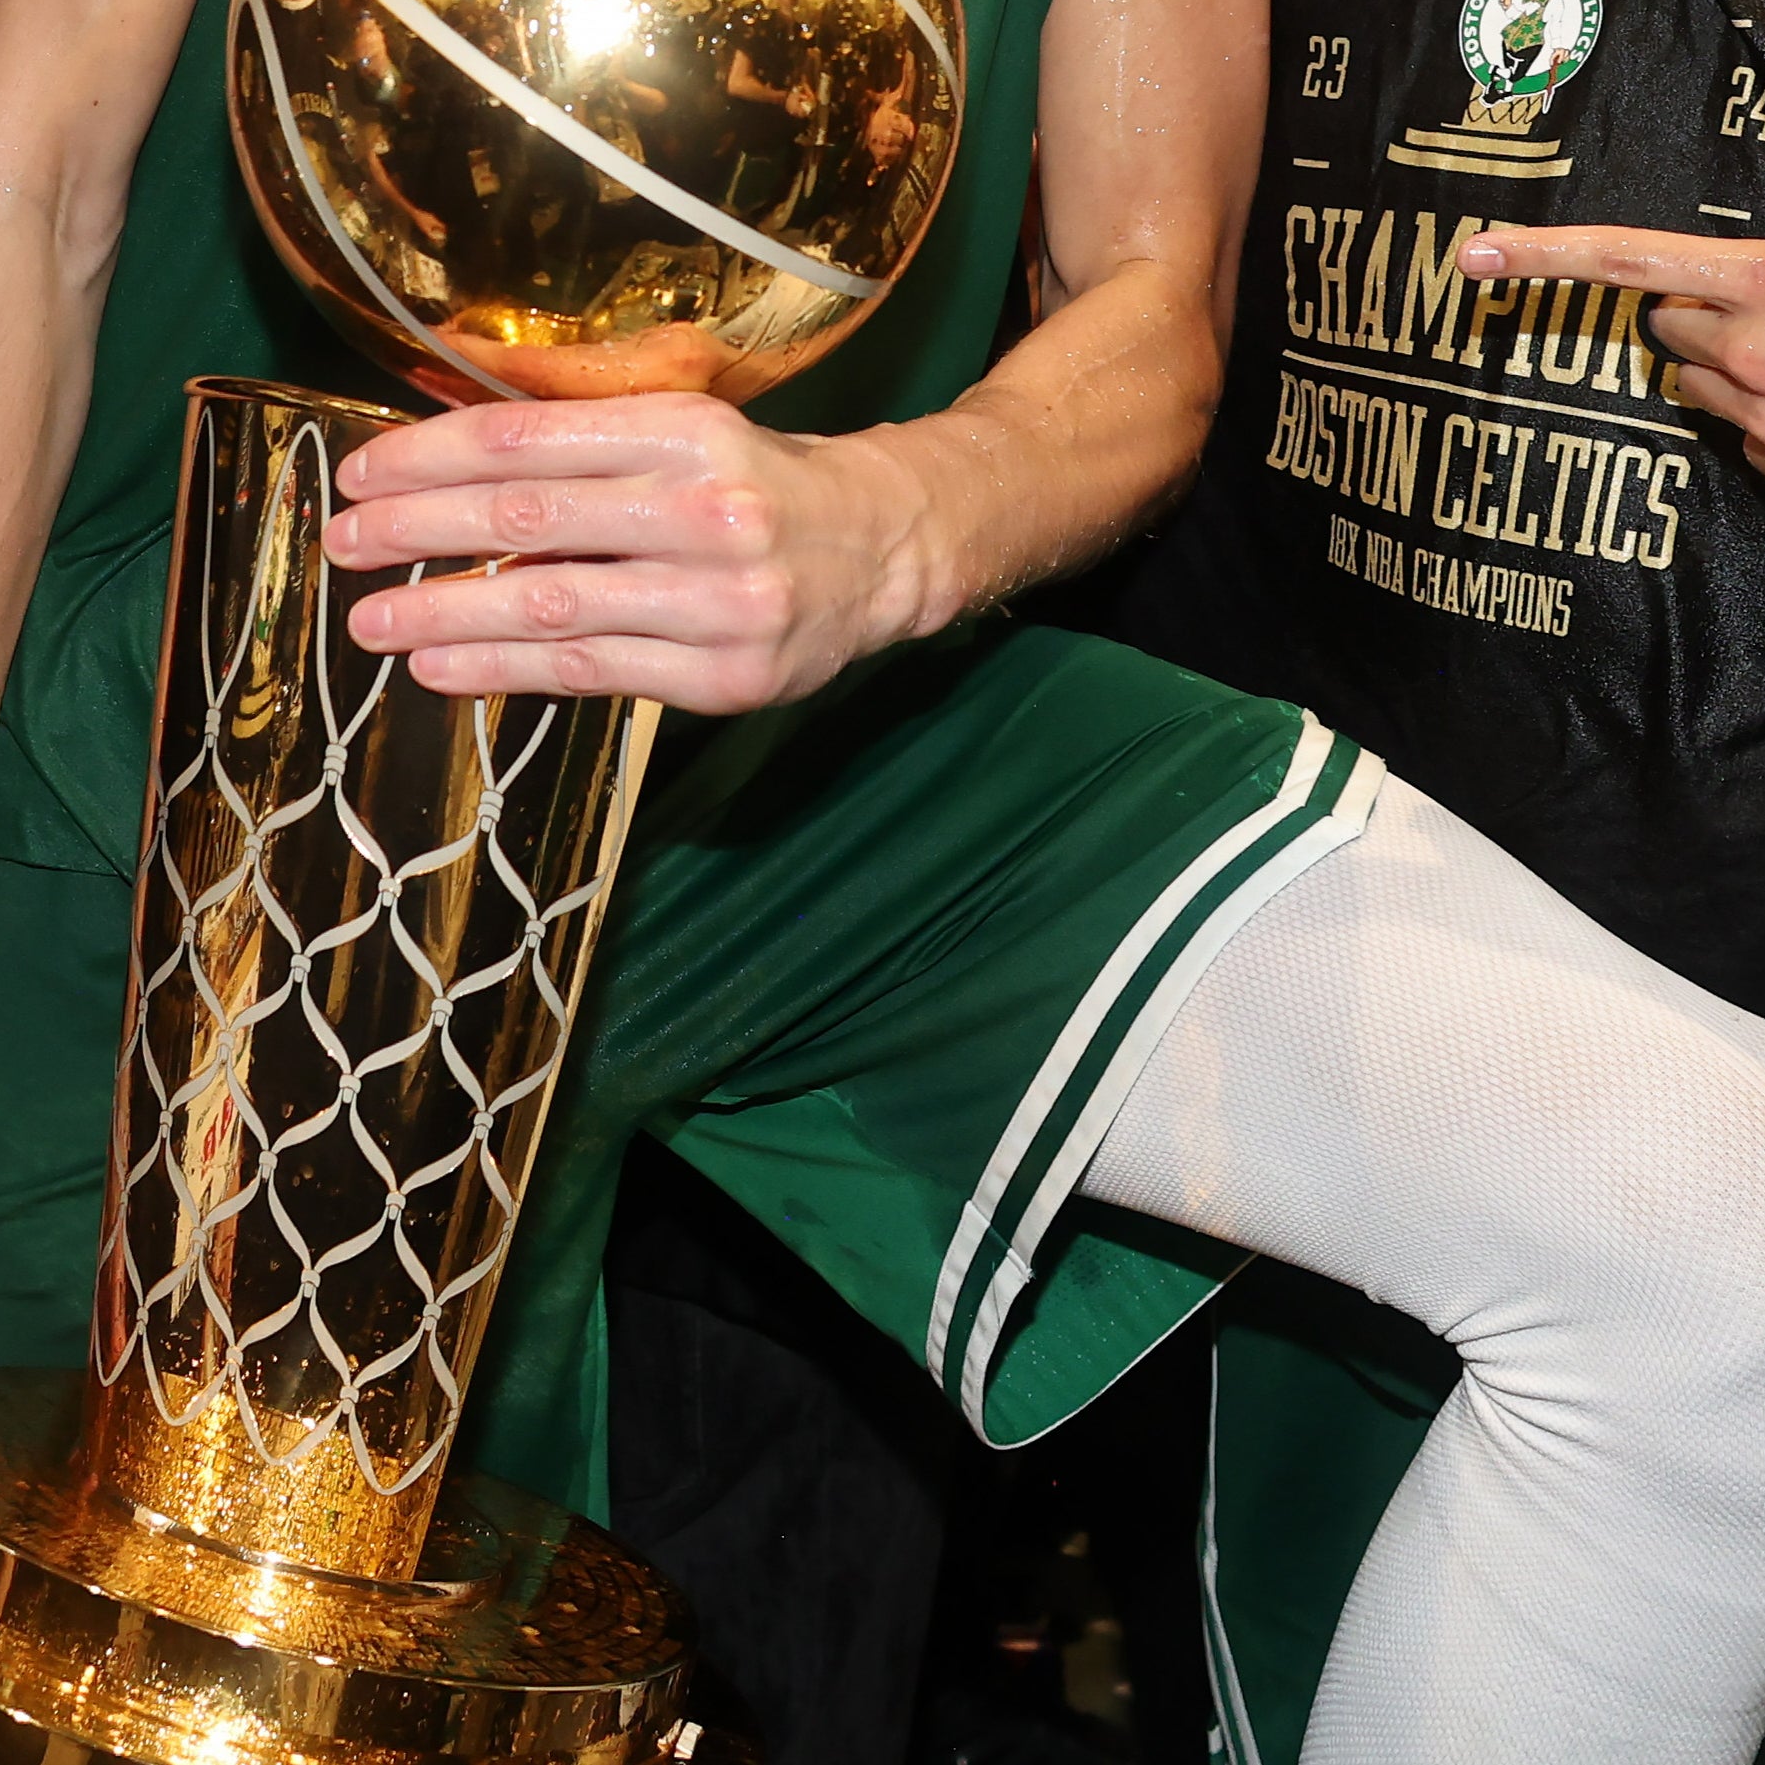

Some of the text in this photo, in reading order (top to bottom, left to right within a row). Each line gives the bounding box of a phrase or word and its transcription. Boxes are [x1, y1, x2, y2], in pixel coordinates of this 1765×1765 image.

[1302, 35, 1351, 100] 23
[1266, 370, 1690, 571] BOSTON CELTICS
[1327, 513, 1575, 638] 18X NBA CHAMPIONS
